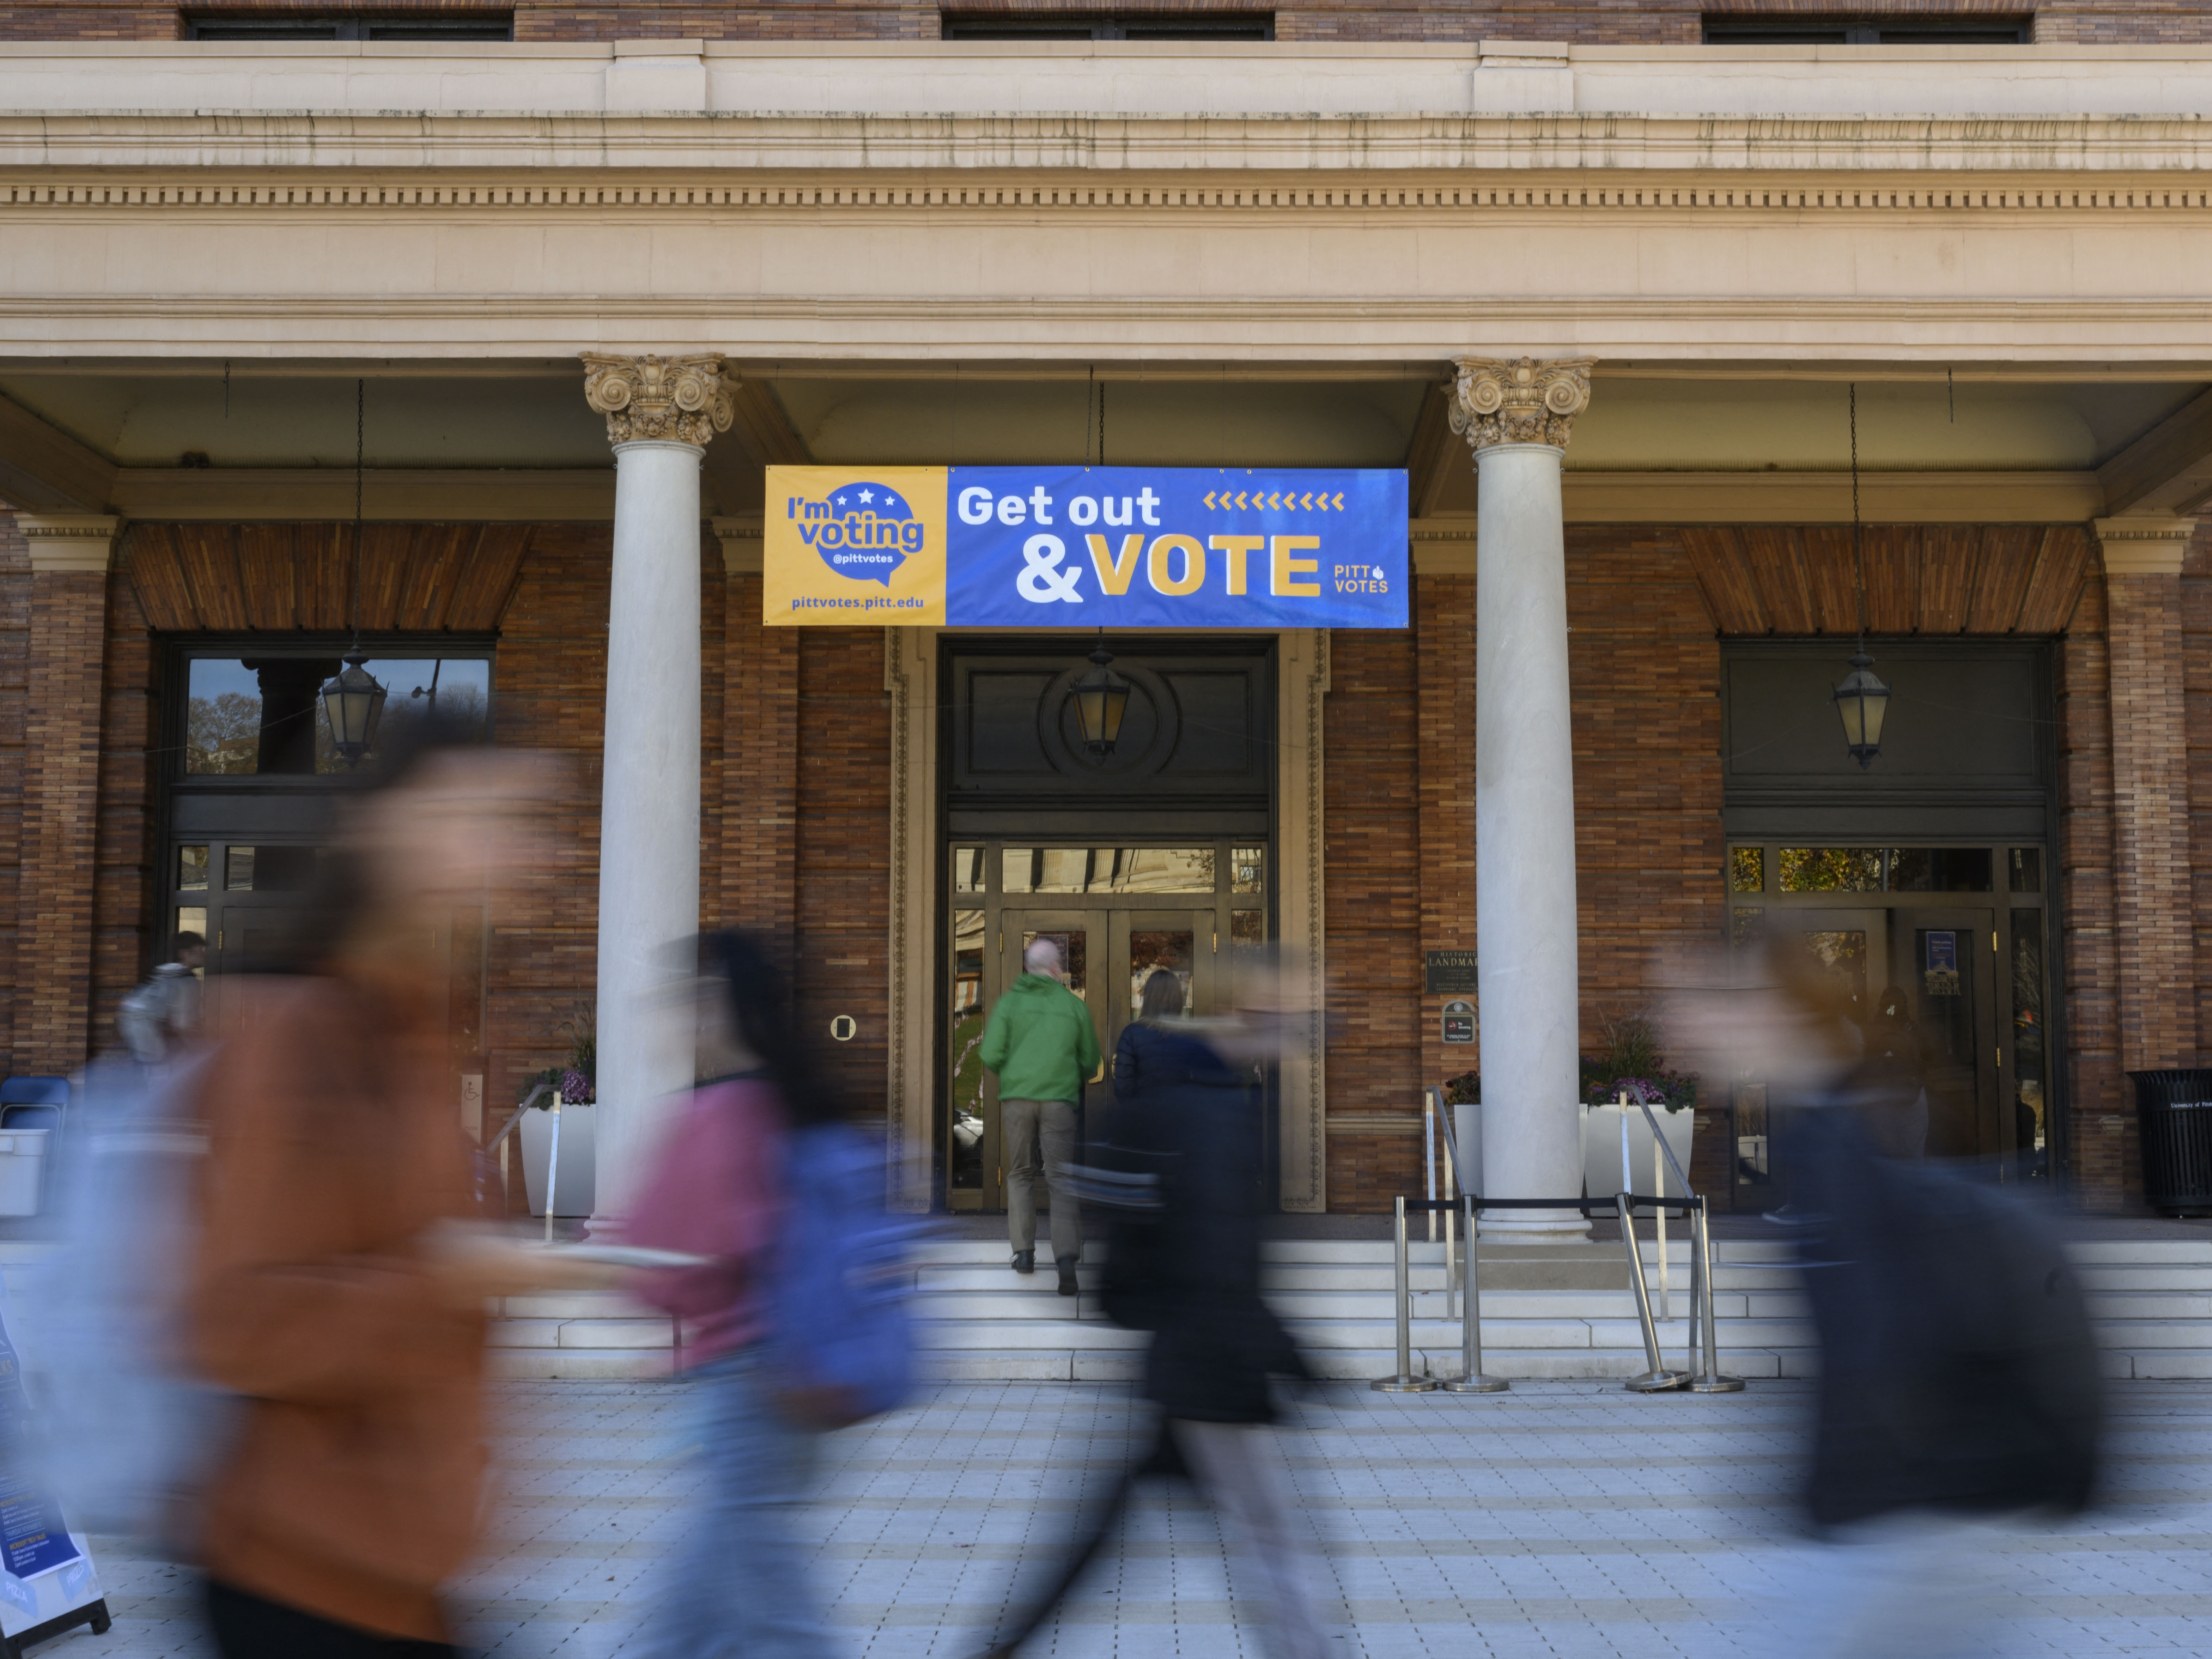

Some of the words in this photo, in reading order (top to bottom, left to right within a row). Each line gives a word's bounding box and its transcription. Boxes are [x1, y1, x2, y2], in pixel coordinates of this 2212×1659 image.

[788, 497, 830, 519] I'm
[958, 486, 1053, 525] Get
[1069, 487, 1160, 526] out
[797, 515, 924, 553] voting
[833, 554, 893, 564] @pittvotes
[1335, 565, 1370, 578] PITT
[1335, 580, 1388, 593] VOTES
[792, 596, 924, 611] pittvotes.pitt.edu
[5, 1581, 28, 1603] PIZZA
